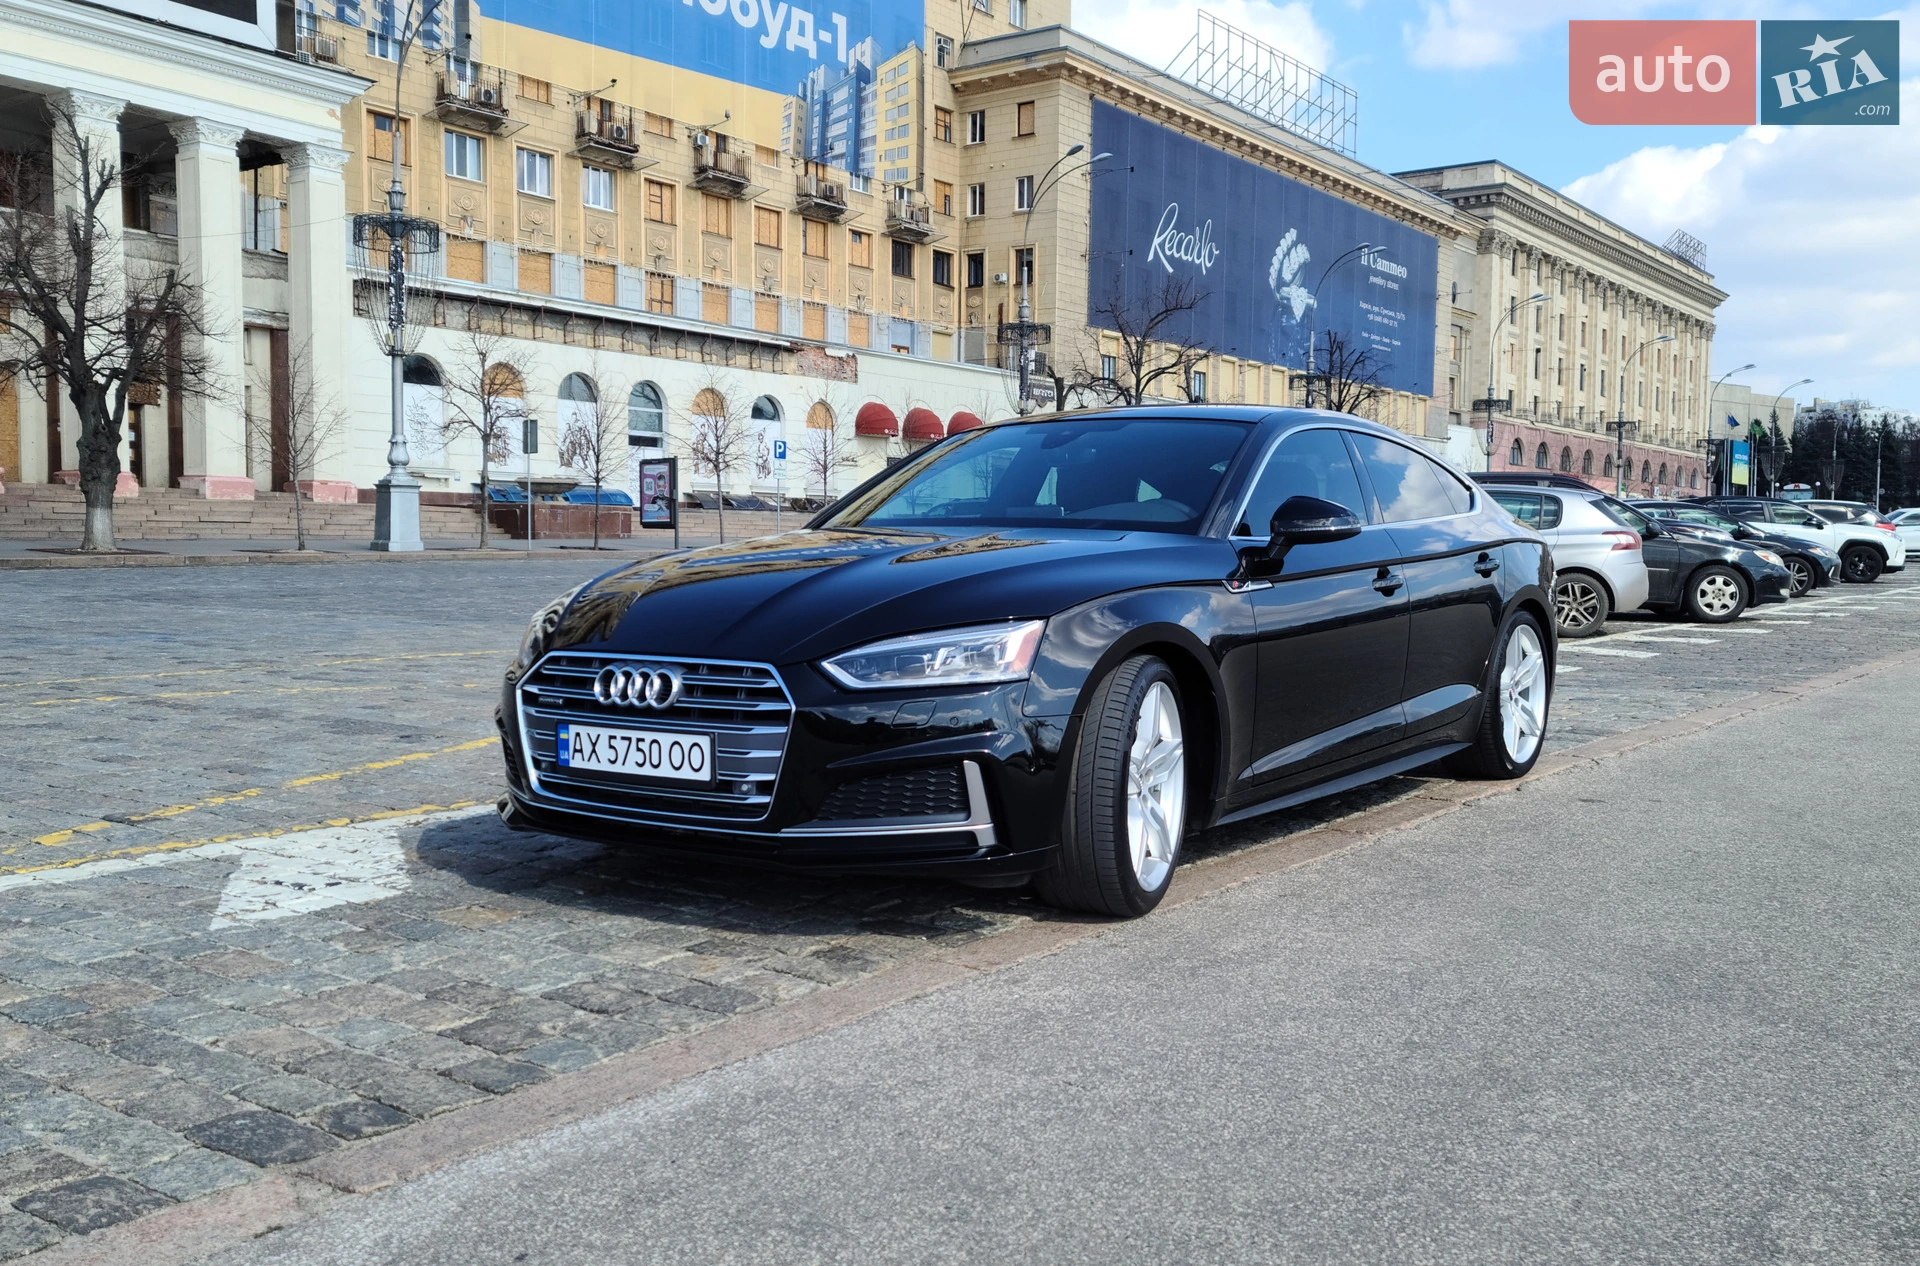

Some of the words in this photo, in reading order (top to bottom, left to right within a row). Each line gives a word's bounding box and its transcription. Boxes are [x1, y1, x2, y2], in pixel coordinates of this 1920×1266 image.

[682, 0, 848, 63] буд-1
[1147, 202, 1220, 275] Recarlo
[1370, 252, 1407, 279] Cammeo
[776, 441, 785, 458] P
[572, 732, 601, 763] AX
[607, 735, 662, 769] 5750
